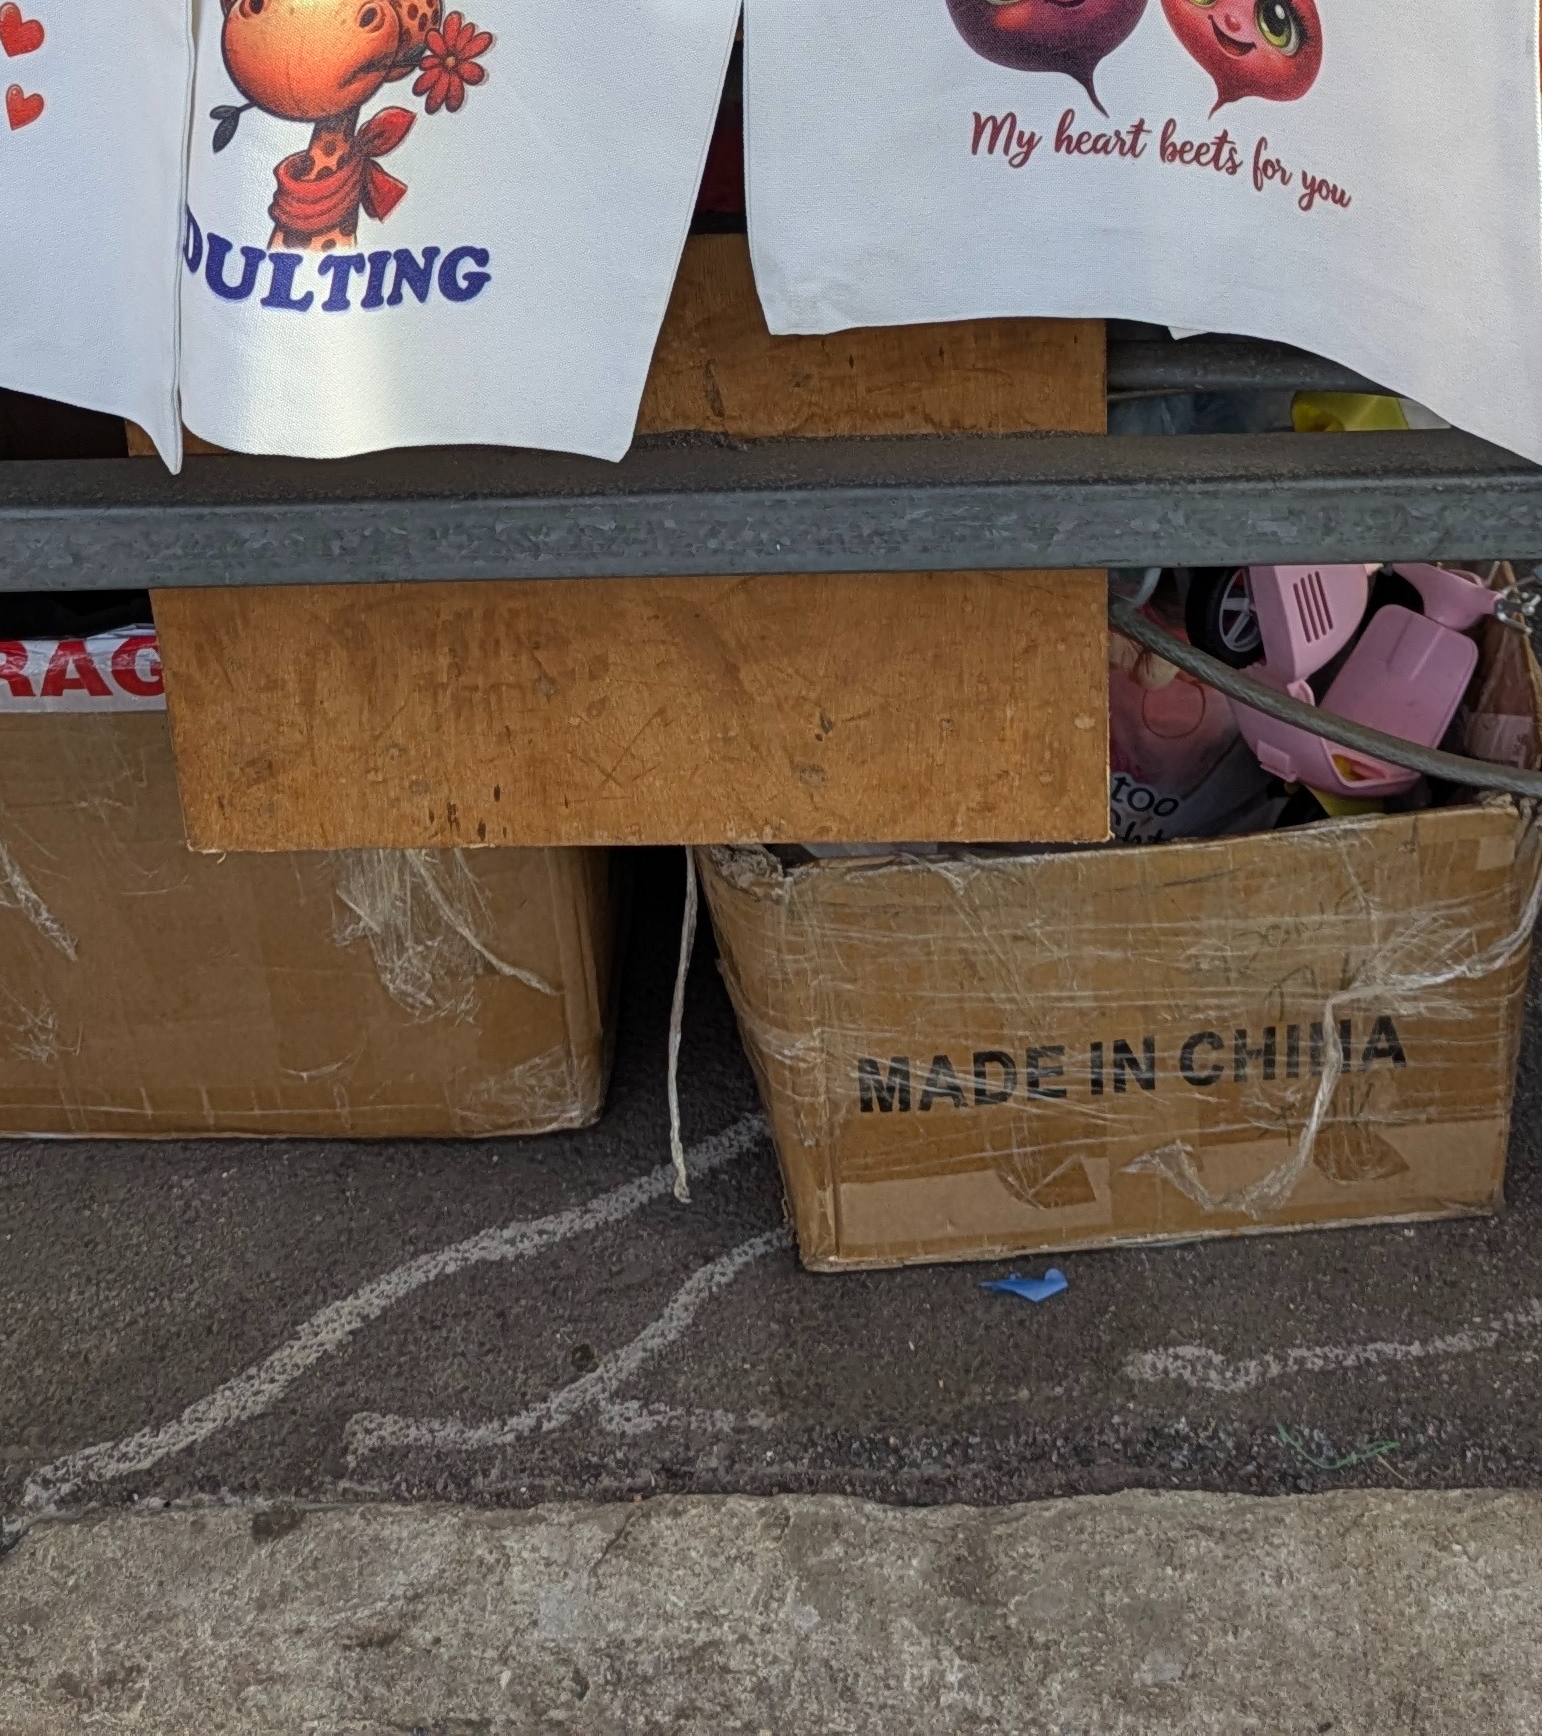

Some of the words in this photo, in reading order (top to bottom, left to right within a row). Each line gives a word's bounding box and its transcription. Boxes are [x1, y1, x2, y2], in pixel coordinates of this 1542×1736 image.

[971, 111, 1043, 169] My
[1054, 108, 1153, 159] heart
[1159, 117, 1244, 176] beets
[1252, 136, 1293, 192] for
[1297, 169, 1352, 212] you
[859, 1044, 1067, 1114] MADE
[1089, 1036, 1157, 1096] IN
